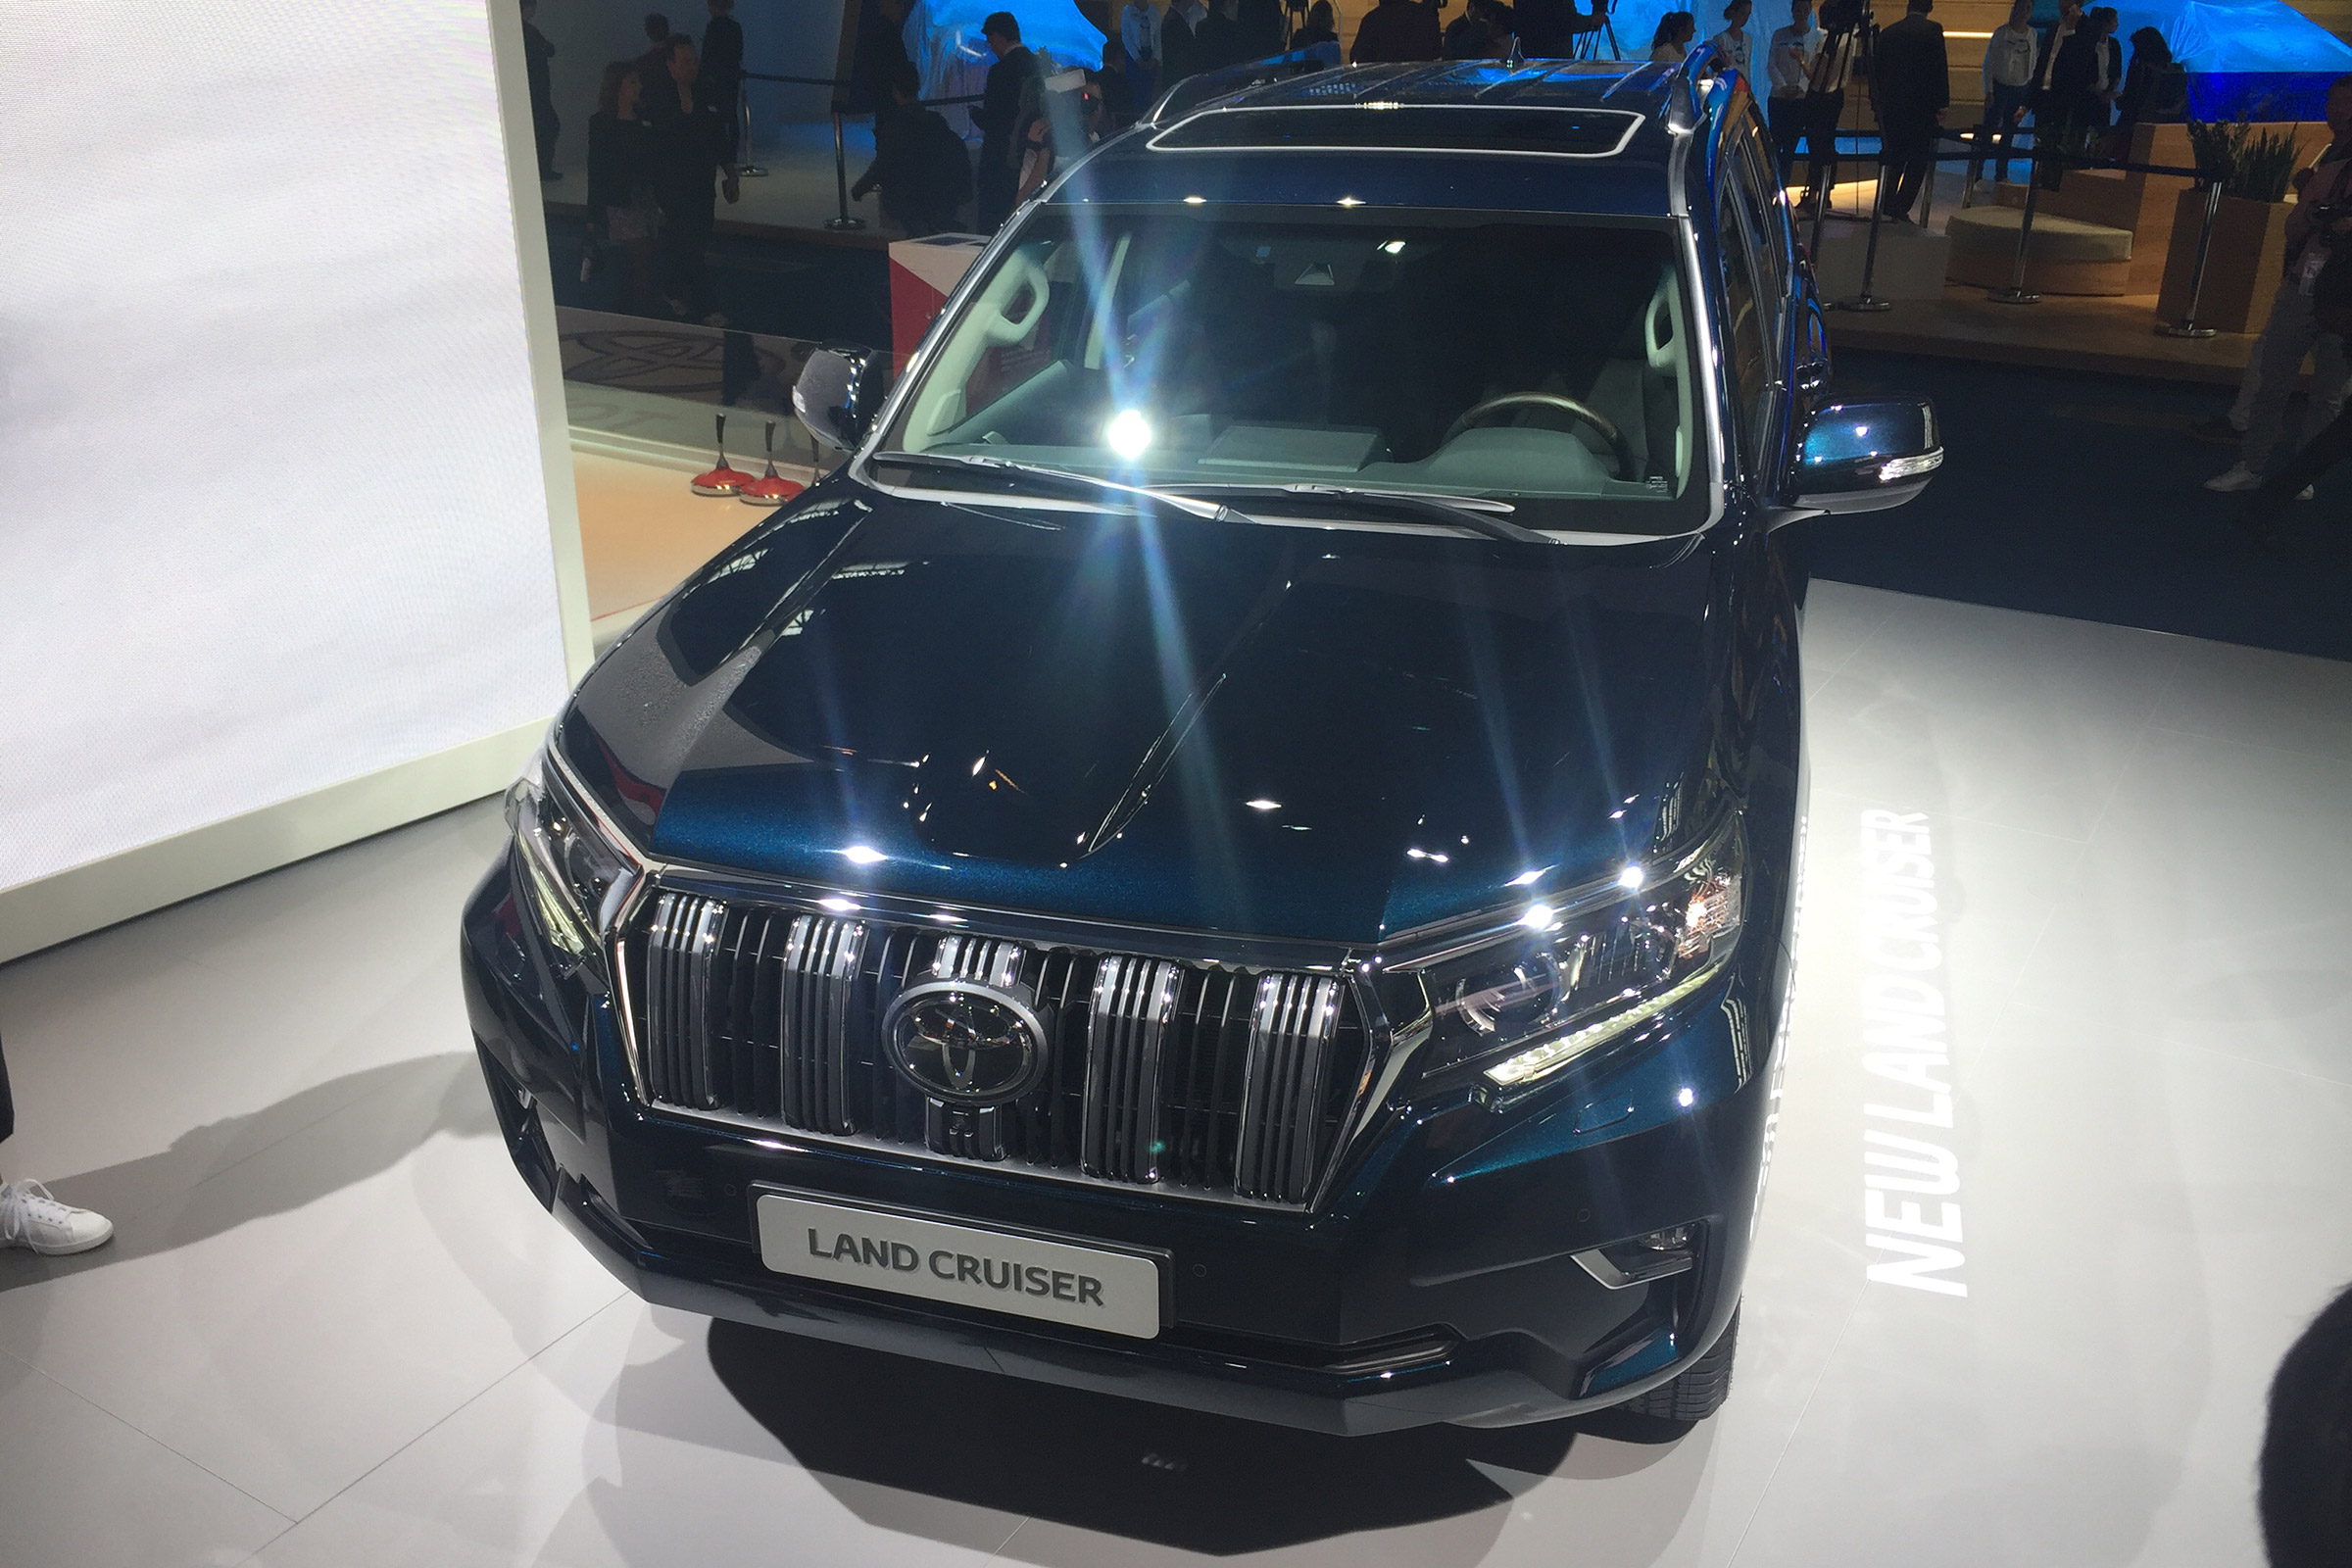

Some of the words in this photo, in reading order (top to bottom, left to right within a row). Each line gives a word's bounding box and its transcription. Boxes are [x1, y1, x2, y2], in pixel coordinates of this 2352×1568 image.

[1862, 808, 1942, 972] CRUISER
[1863, 980, 1953, 1129] LAND
[808, 1227, 919, 1272] LAND
[928, 1249, 1104, 1307] CRUISER
[1863, 1129, 1968, 1298] NEW
